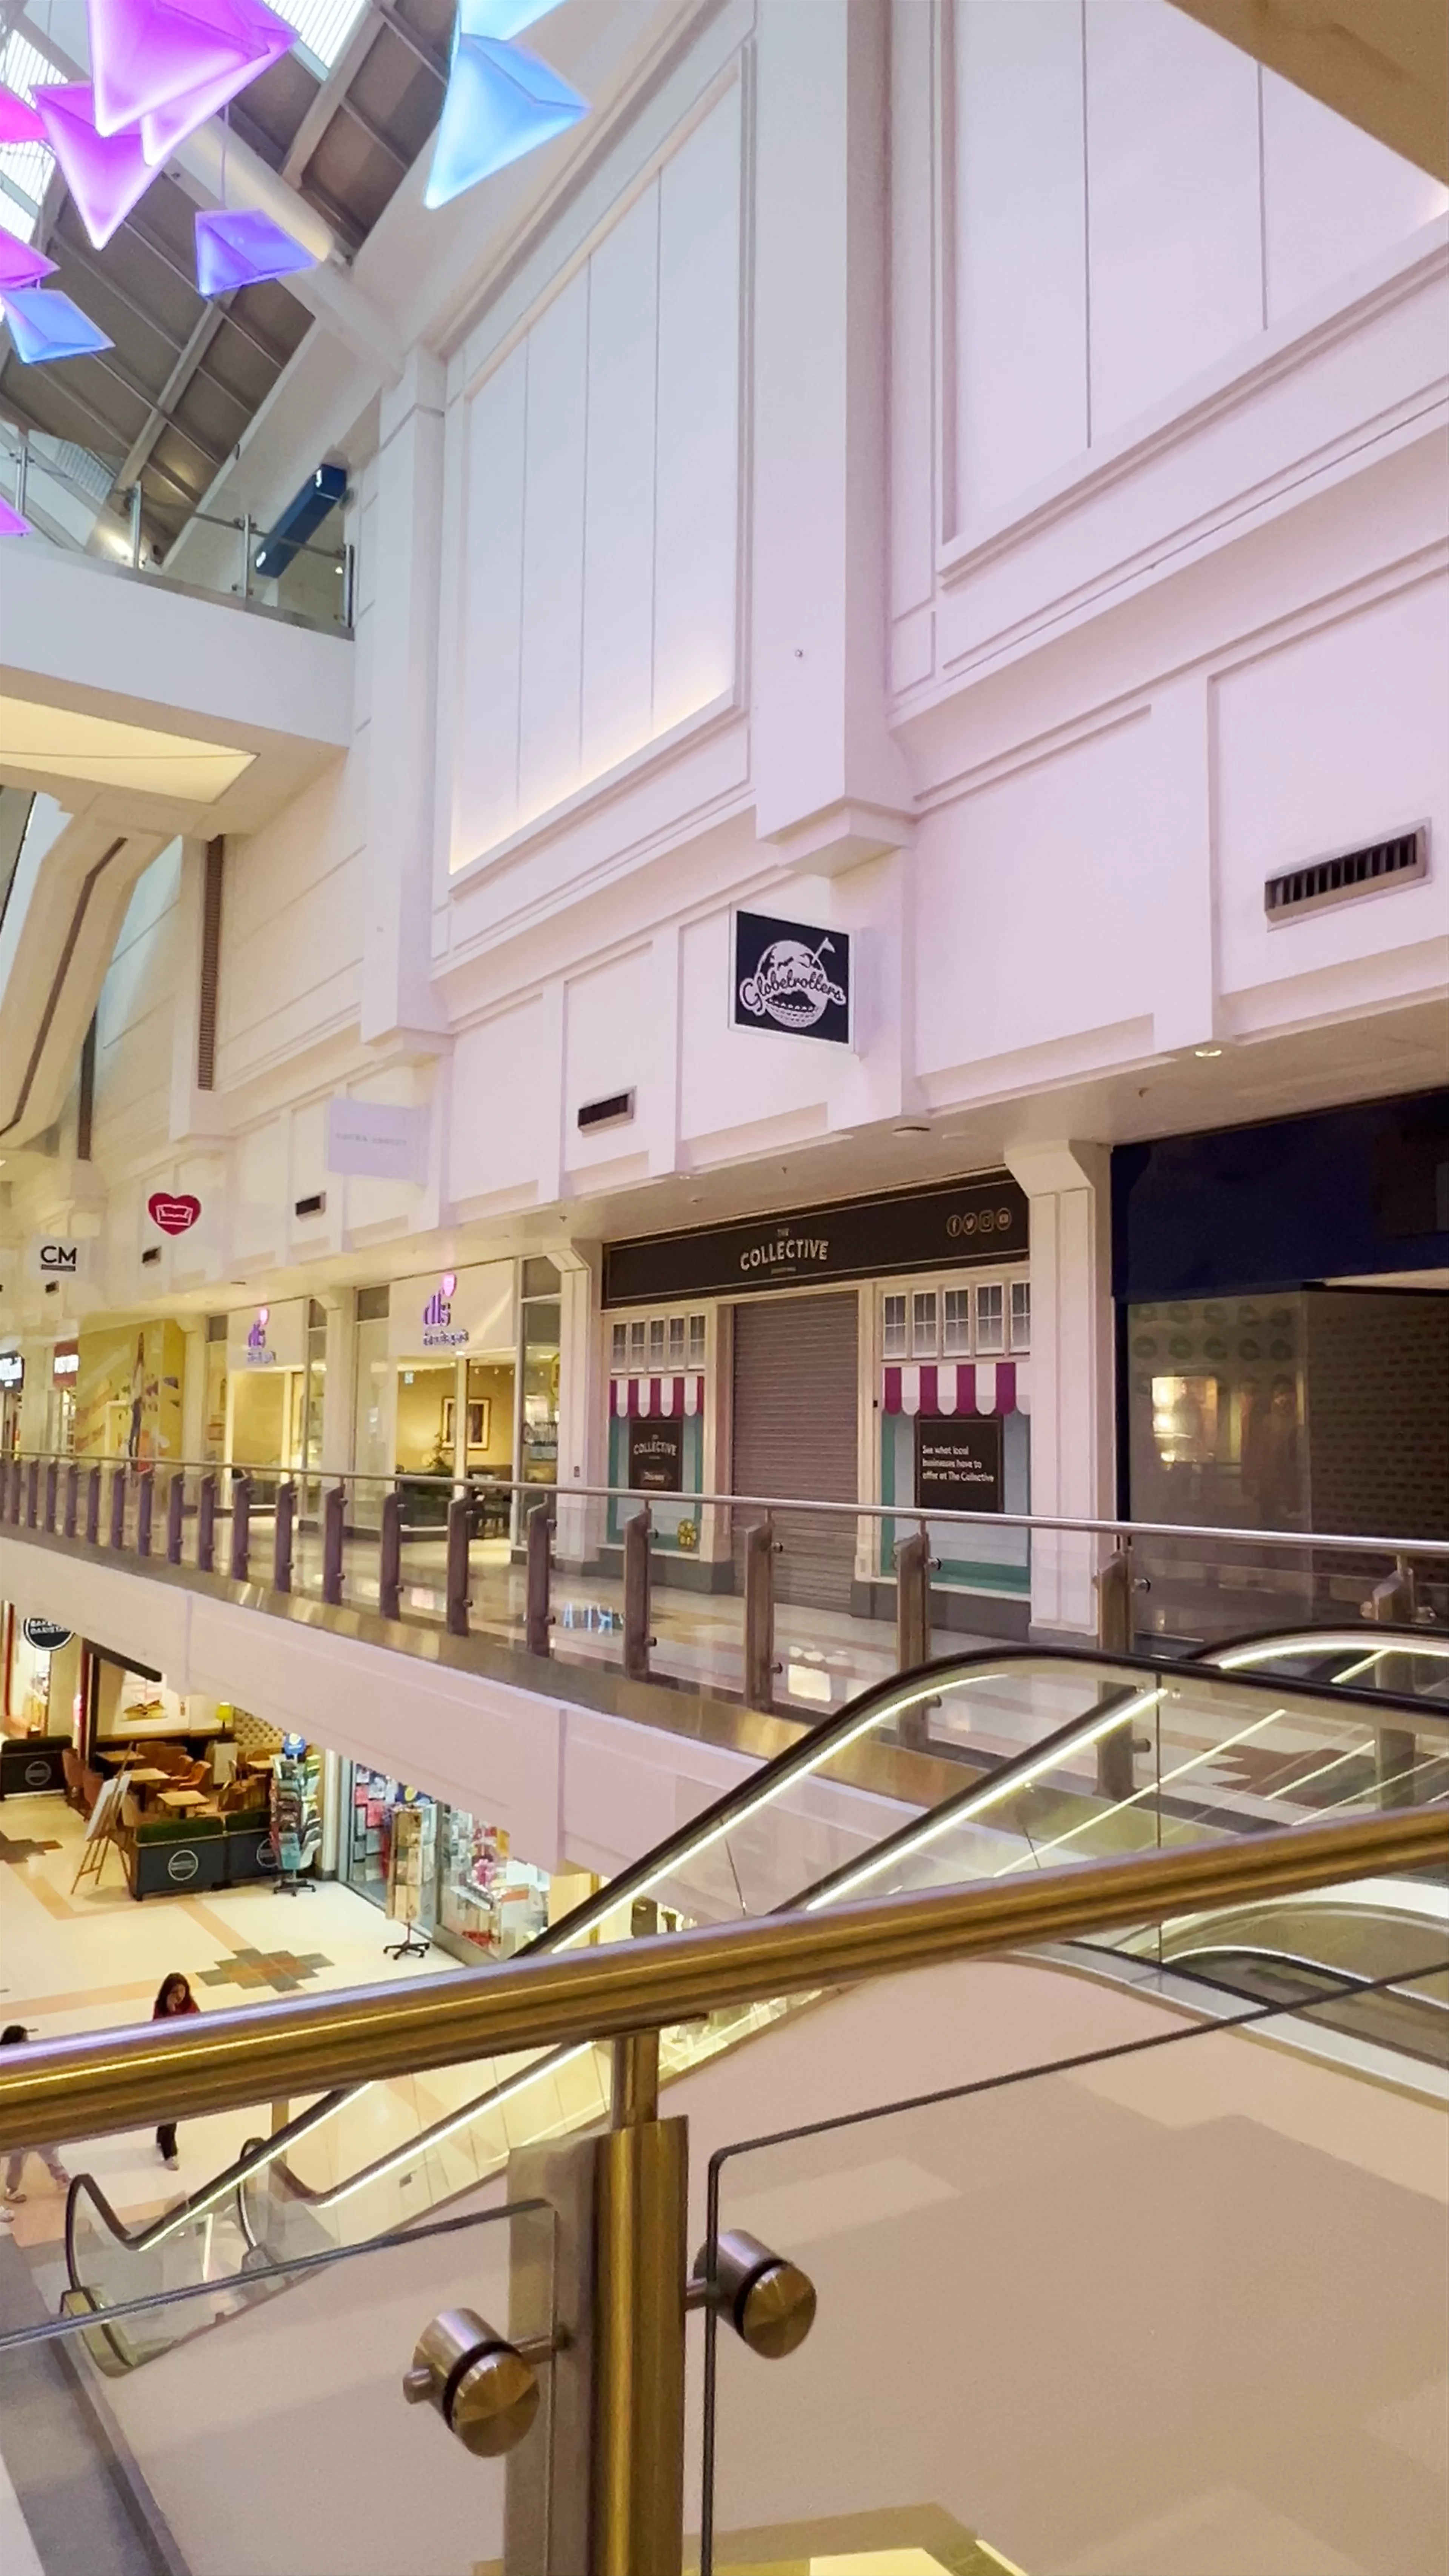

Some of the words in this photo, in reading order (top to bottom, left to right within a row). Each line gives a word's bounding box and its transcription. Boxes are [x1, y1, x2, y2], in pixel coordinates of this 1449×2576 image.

[742, 969, 844, 1013] Globetrotters
[40, 1245, 77, 1264] CM
[740, 1239, 829, 1271] COLLECTIVE
[633, 1441, 677, 1456] COLLECTIVE
[935, 1446, 952, 1455] what
[952, 1446, 969, 1455] local
[956, 1459, 973, 1469] have
[974, 1460, 982, 1469] to
[948, 1471, 960, 1481] The
[961, 1472, 994, 1482] Collective
